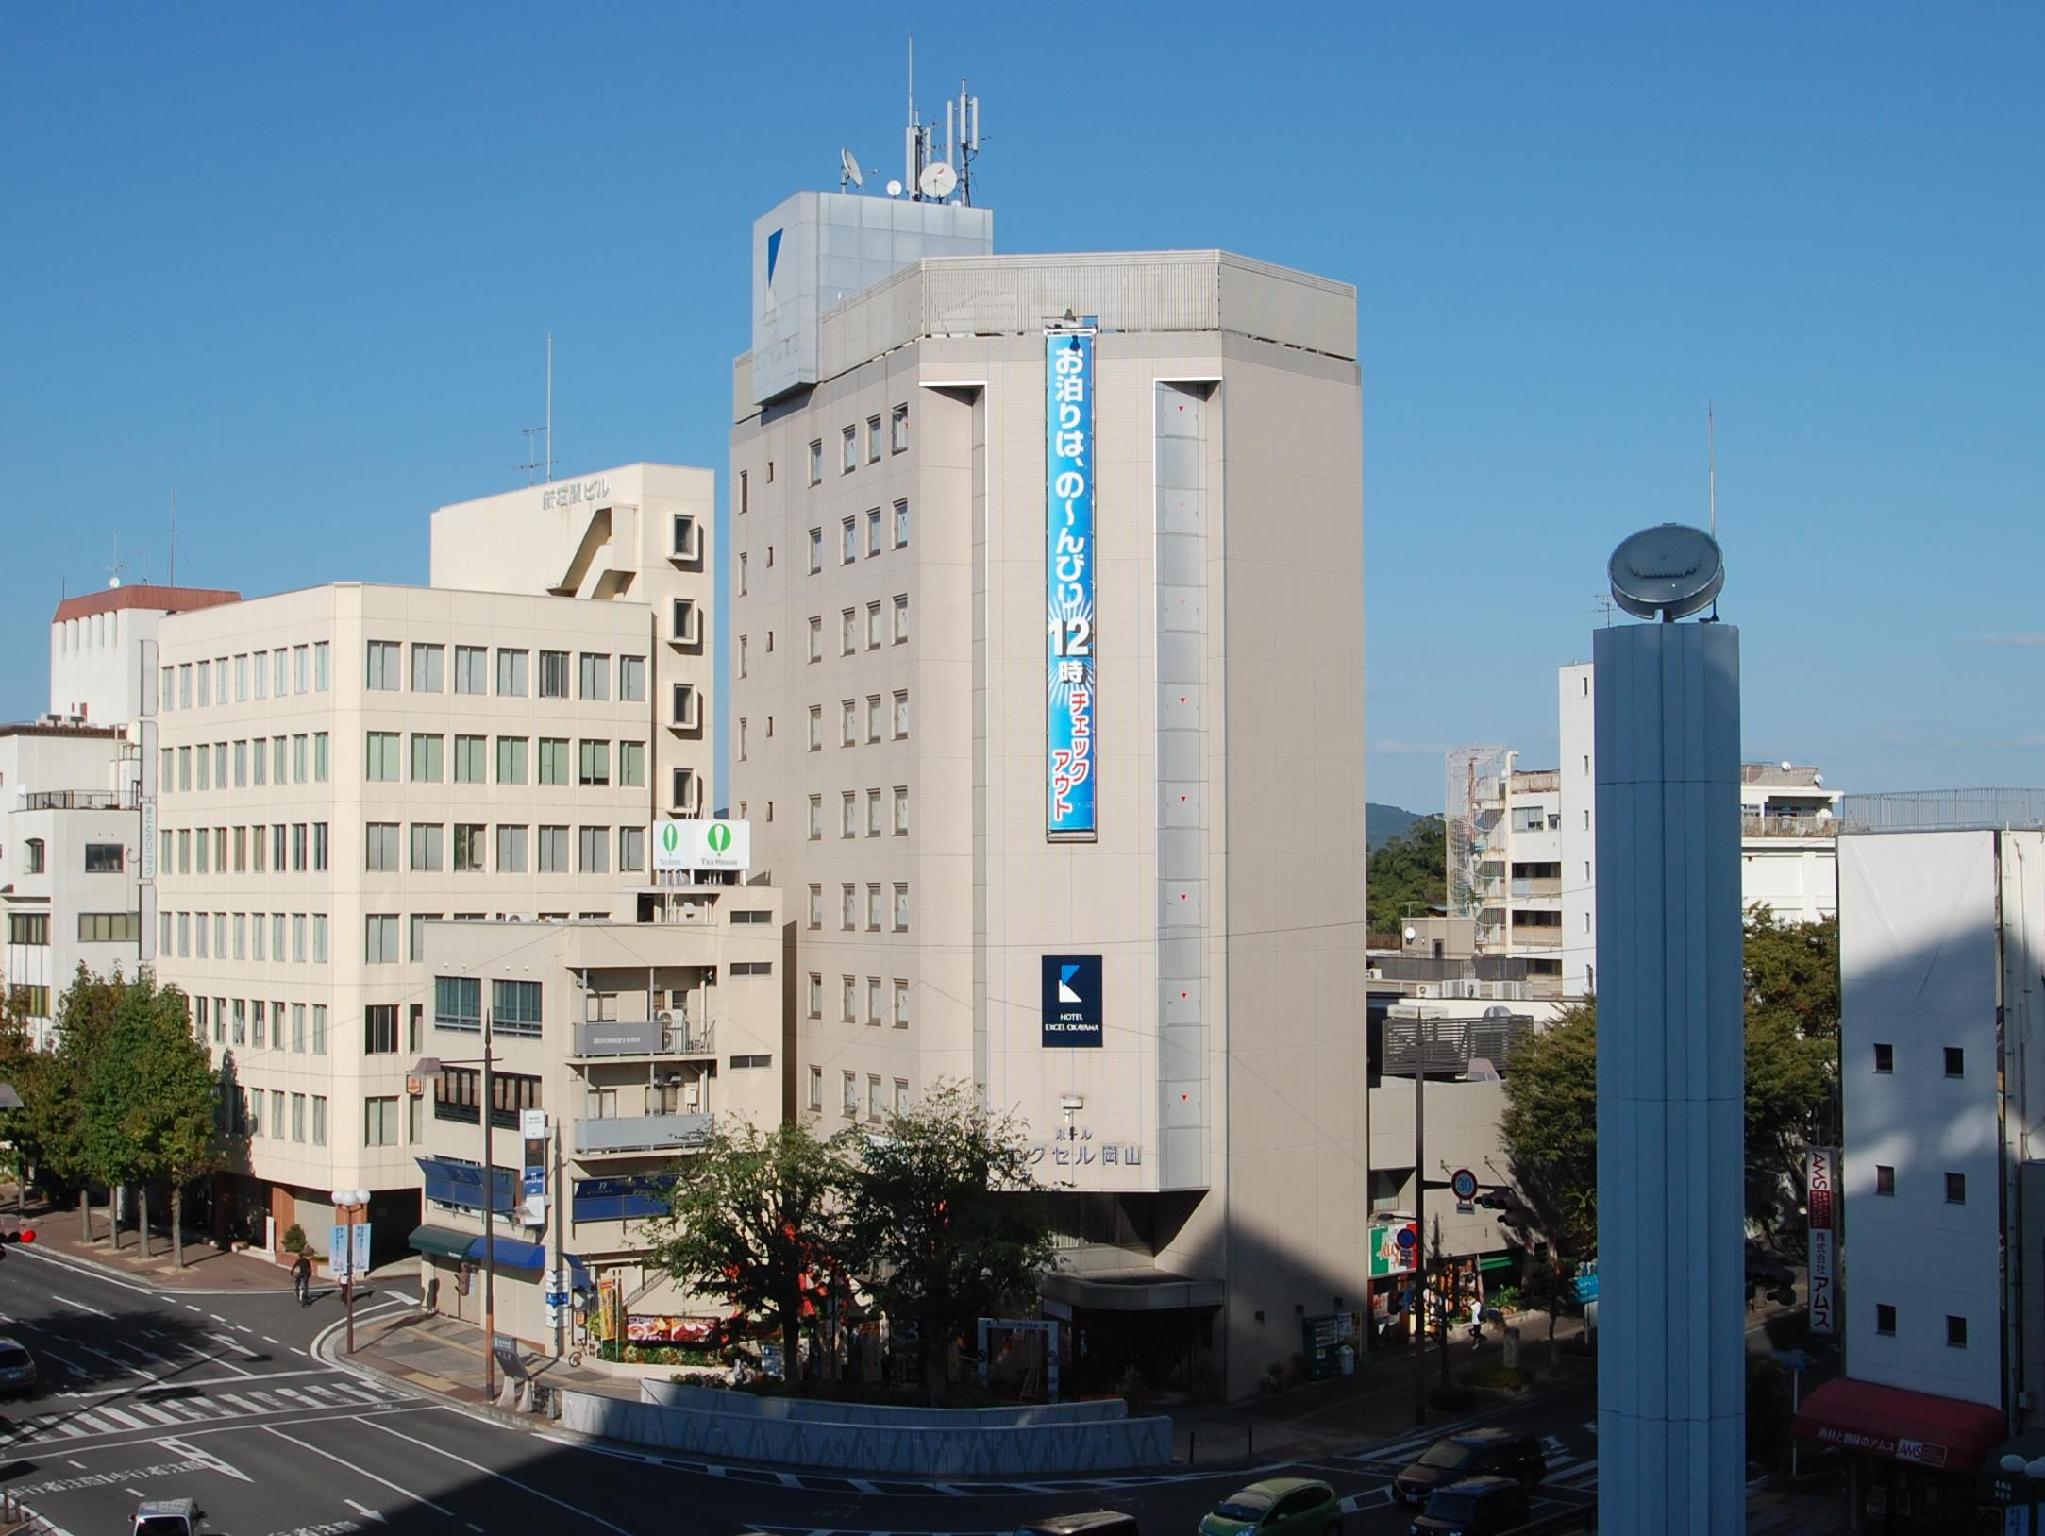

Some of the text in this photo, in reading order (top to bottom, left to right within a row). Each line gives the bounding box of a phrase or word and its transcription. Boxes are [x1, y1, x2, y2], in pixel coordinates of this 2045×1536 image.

[1060, 1013, 1083, 1021] HOTEL
[1045, 1023, 1099, 1032] EXCEL OKAYAMA
[1811, 1152, 1828, 1190] AMS
[1458, 1177, 1472, 1192] 30
[1899, 1443, 1921, 1458] AMS
